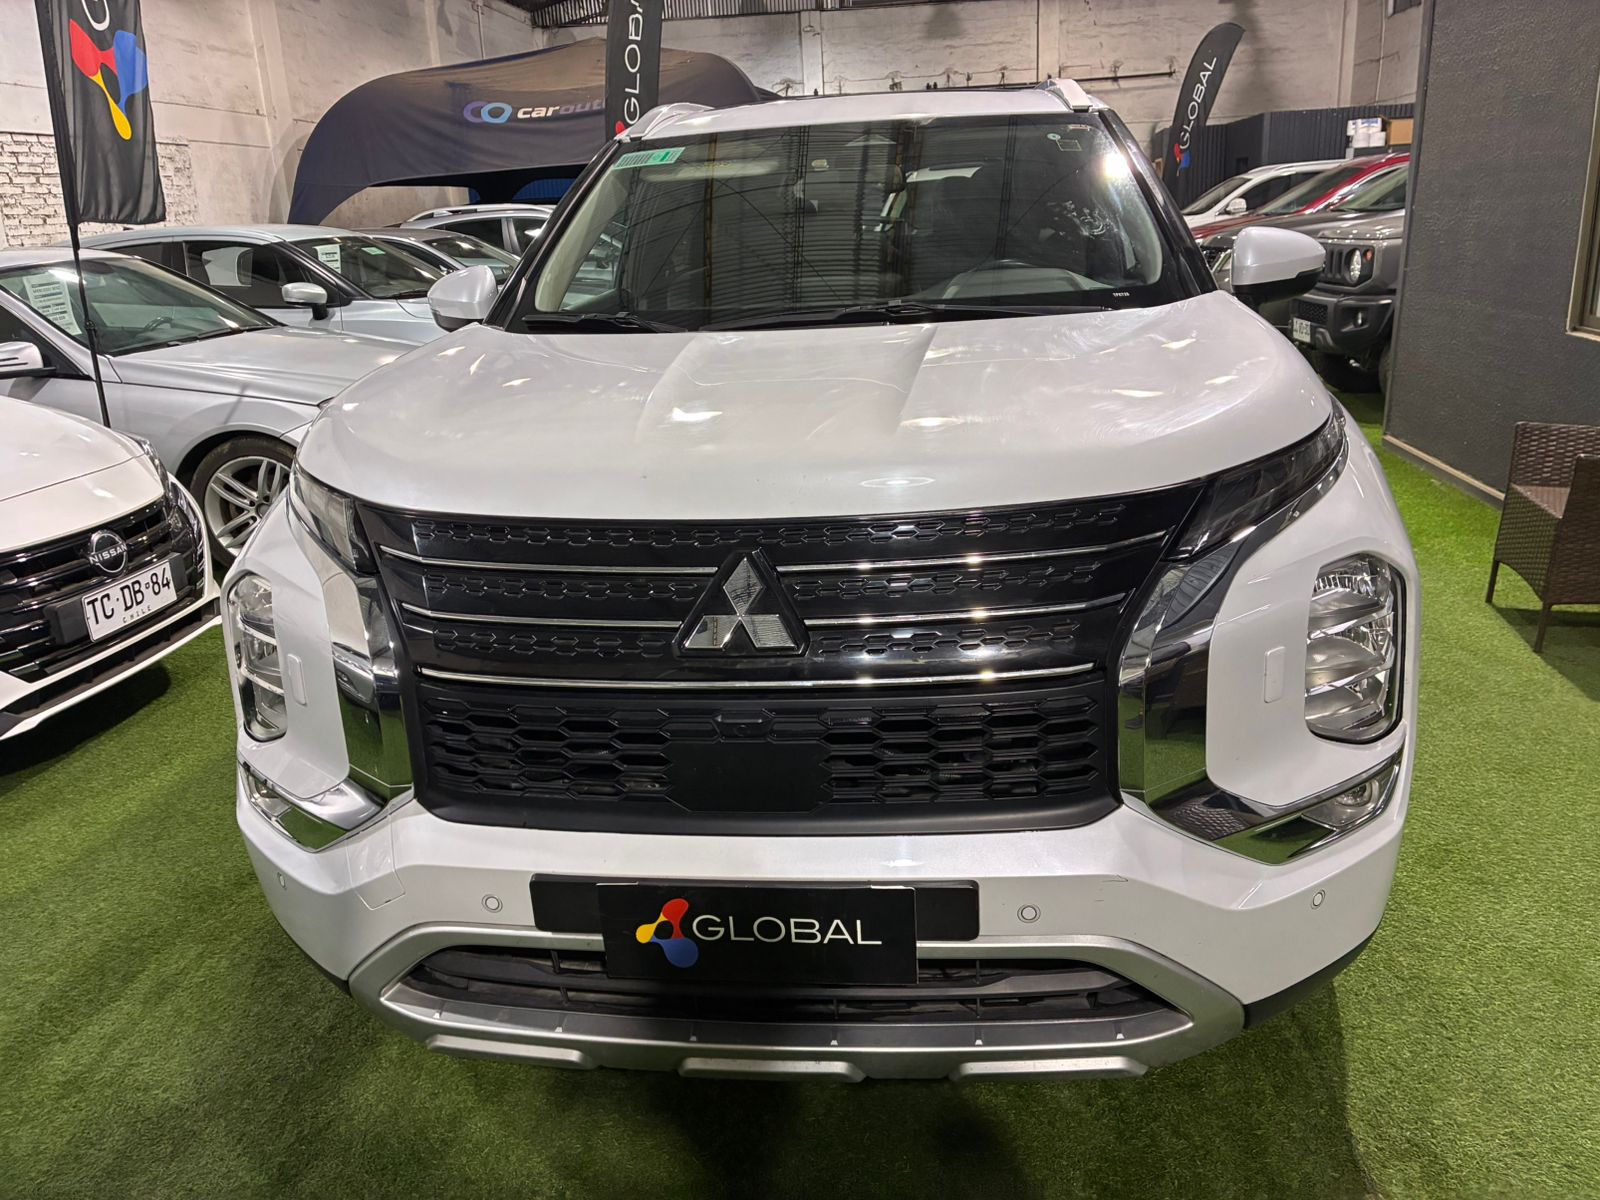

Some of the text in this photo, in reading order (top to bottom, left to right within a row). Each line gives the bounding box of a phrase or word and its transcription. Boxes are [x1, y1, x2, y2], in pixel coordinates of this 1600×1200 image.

[517, 98, 606, 119] carout
[1180, 57, 1217, 150] GLOBAL
[89, 543, 127, 564] NISSAN
[122, 605, 152, 623] CHILE
[692, 914, 882, 945] GLOBAL
